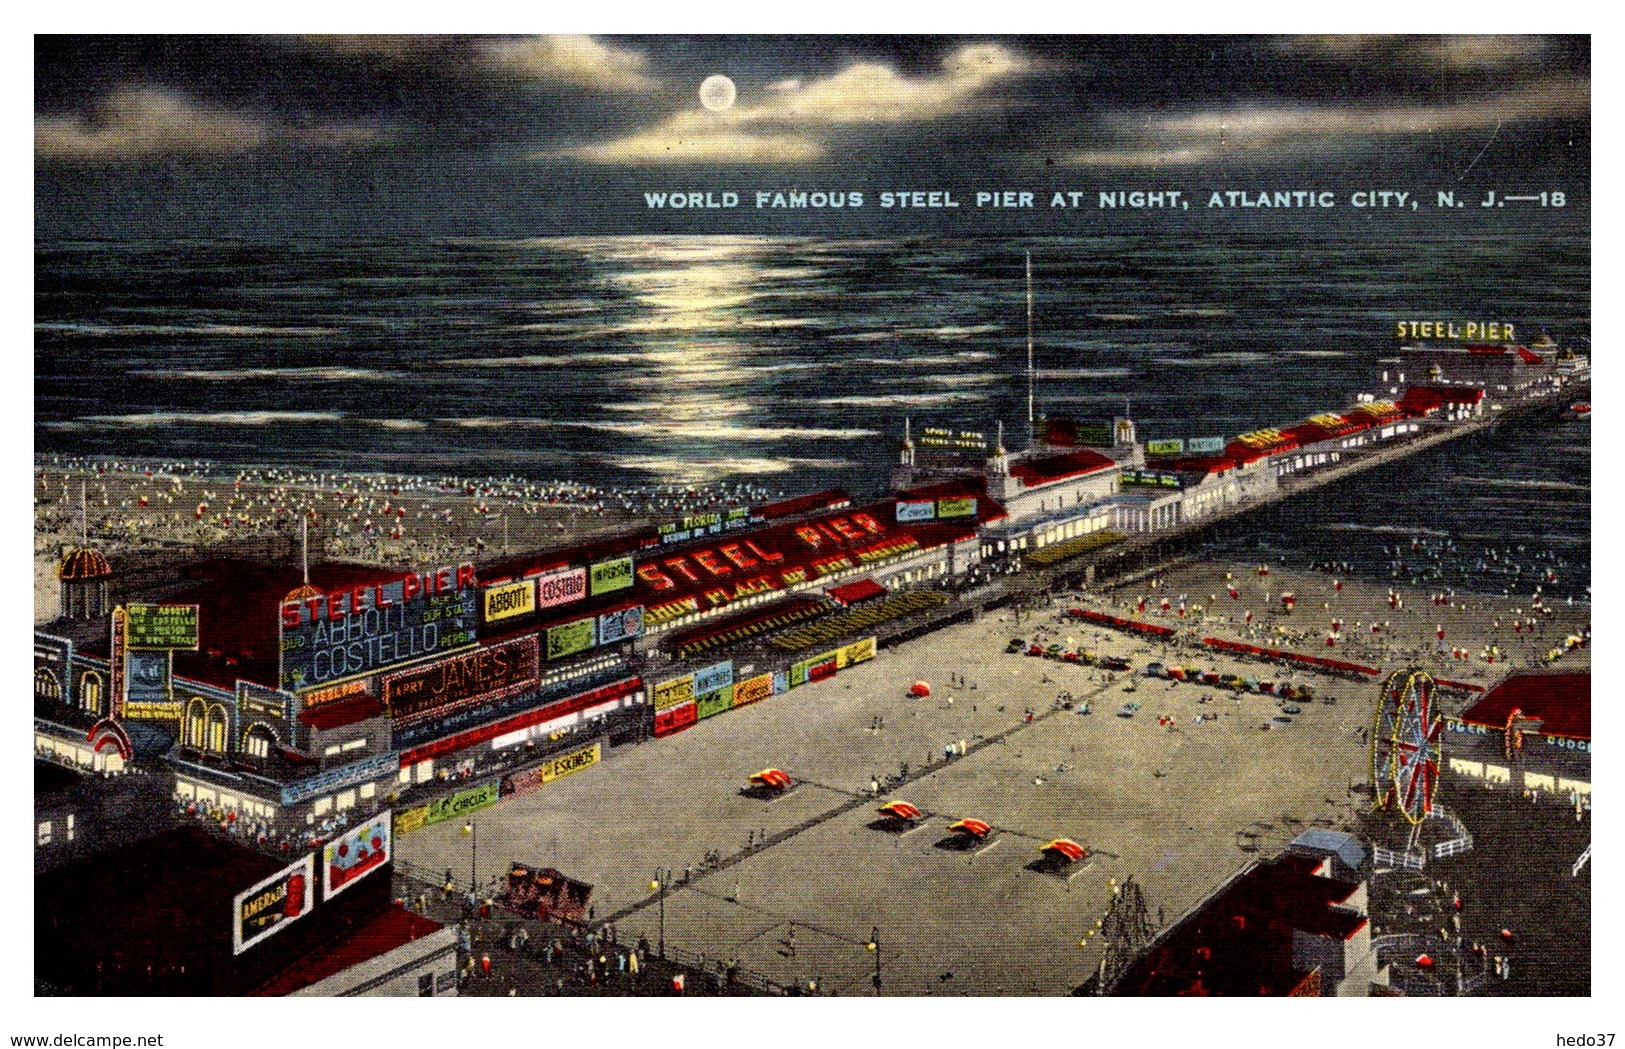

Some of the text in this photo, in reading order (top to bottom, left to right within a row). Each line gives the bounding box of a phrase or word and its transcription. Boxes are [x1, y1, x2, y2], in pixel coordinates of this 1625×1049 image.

[1397, 321, 1516, 341] STEEL PIER
[636, 512, 887, 593] STEEL PIER
[281, 561, 475, 629] STEEL PIER
[490, 586, 527, 616] ABBOTT
[543, 575, 583, 601] COSTELLO
[314, 623, 438, 682] COSTELLO
[431, 648, 508, 694] JAMES
